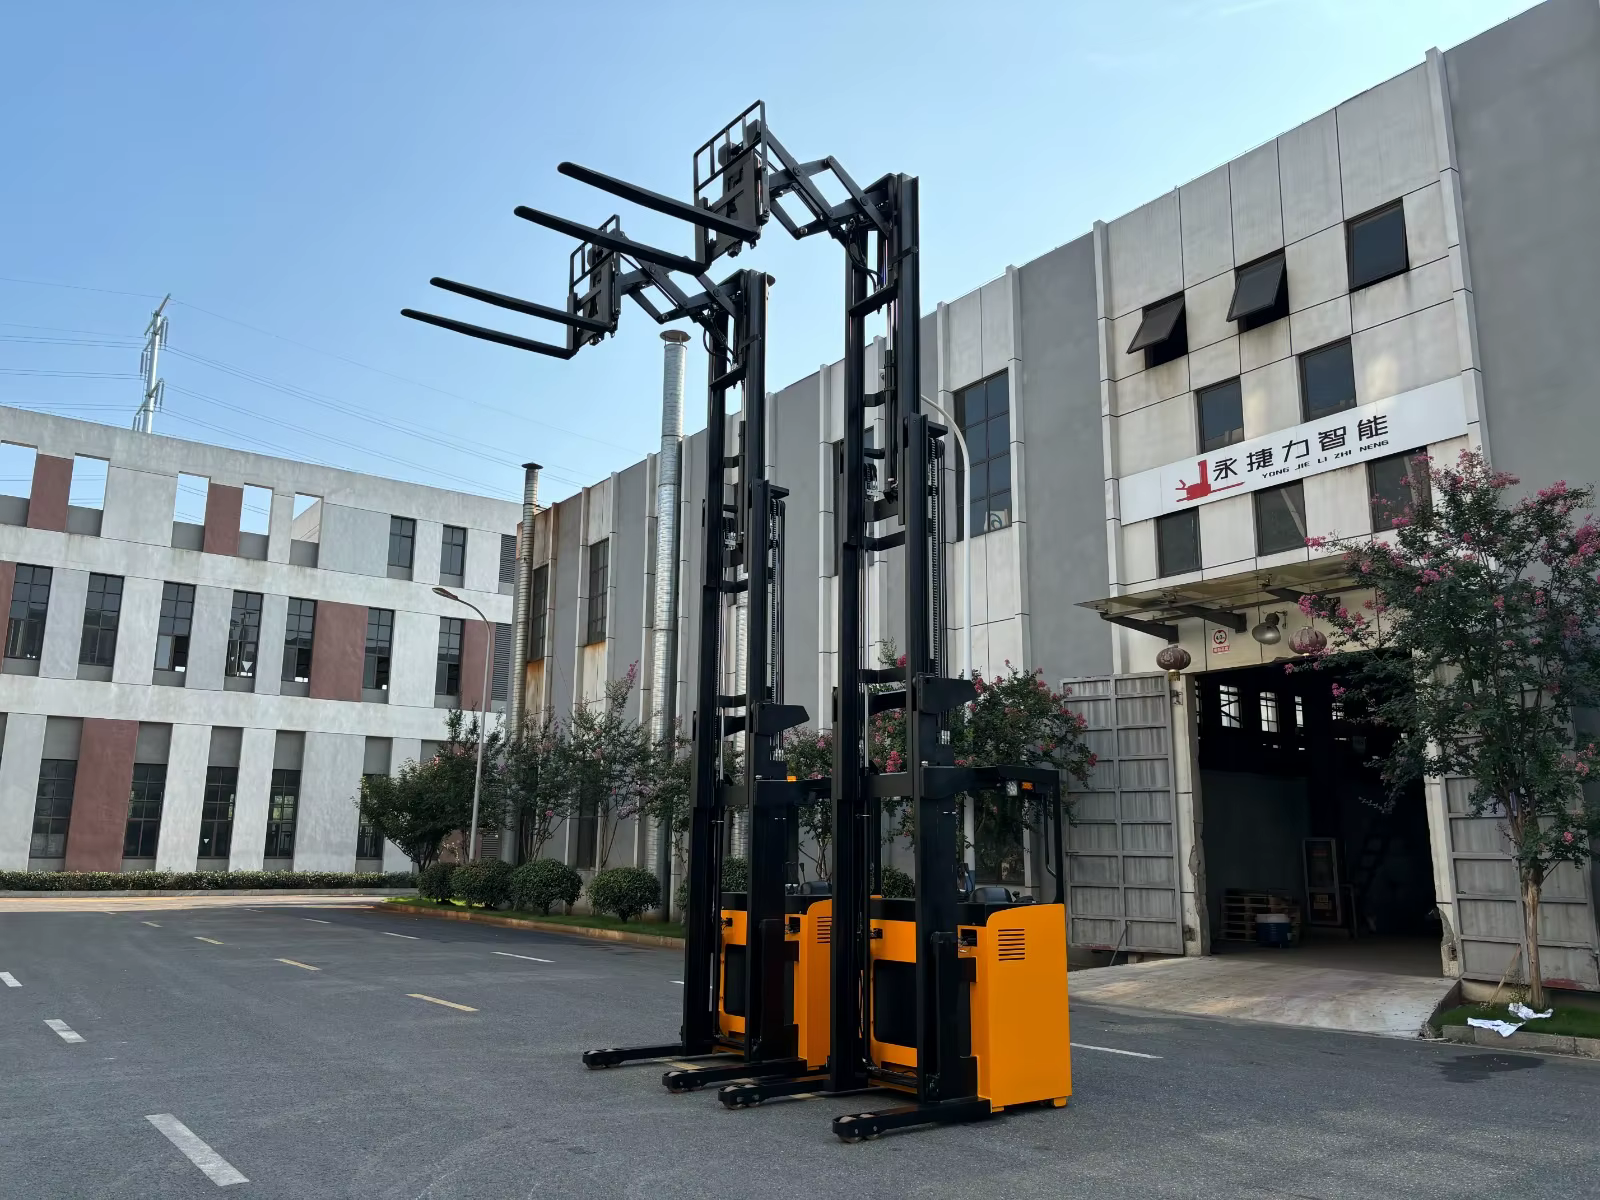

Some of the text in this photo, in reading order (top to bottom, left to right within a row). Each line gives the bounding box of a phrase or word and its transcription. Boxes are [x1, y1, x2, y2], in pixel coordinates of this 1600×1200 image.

[1213, 415, 1389, 481] 永捷力智能
[1262, 440, 1389, 479] YONG JIE LI ZHI NENG
